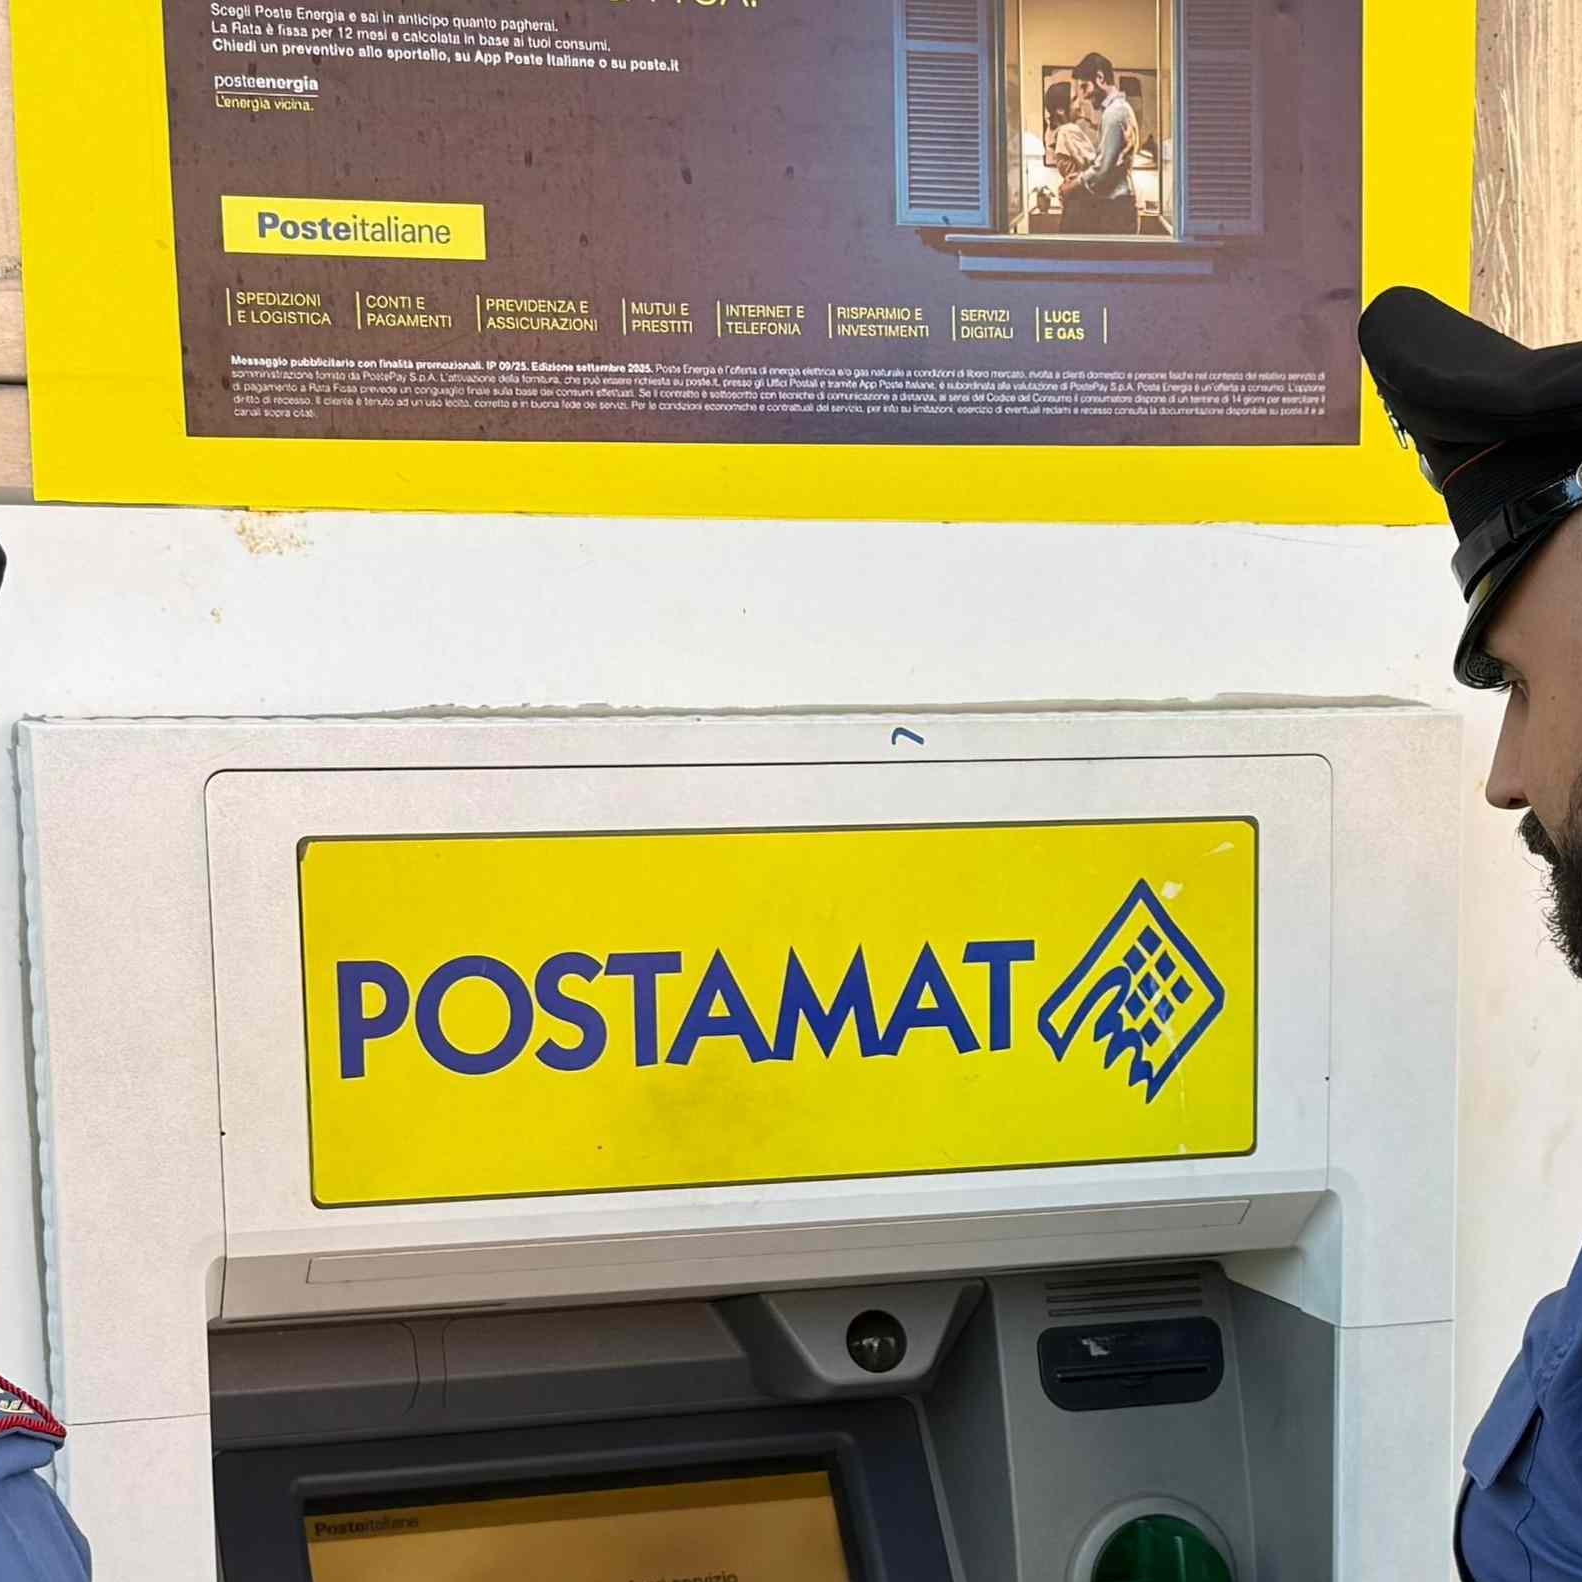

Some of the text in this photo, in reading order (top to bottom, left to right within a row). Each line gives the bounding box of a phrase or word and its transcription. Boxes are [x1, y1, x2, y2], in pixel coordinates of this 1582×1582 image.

[210, 2, 558, 33] Scegli Poste Energia e sai in anticipo quanto pagherai.
[211, 21, 610, 51] La Rata è fissa per 12 mesi e calcolata in base ai tuoi consumi.
[212, 38, 680, 74] Chiedi un preventivo allo sportello, su App Poste Italiane o su poste.it
[214, 75, 319, 93] posteenergia
[215, 95, 315, 112] L'energia vicina.
[257, 210, 451, 246] Posteitaliane
[235, 292, 321, 308] SPEDIZIONI
[366, 295, 425, 310] CONTI E
[486, 298, 588, 314] PREVIDENZA E
[632, 301, 689, 316] MUTUI E
[726, 304, 804, 319] INTERNET E
[837, 306, 923, 322] RISPARMIO E
[961, 308, 1010, 323] SERVIZI
[1044, 309, 1080, 324] LUCE
[238, 310, 332, 326] E LOGISTICA
[367, 312, 452, 328] PAGAMENTI
[487, 315, 598, 332] ASSICURAZIONI
[632, 319, 694, 335] PRESTITI
[727, 322, 802, 336] TELEFONIA
[837, 323, 930, 338] INVESTIMENTI
[961, 325, 1014, 340] DIGITALI
[1045, 326, 1084, 341] E GAS
[337, 938, 1035, 1079] POSTAMAT
